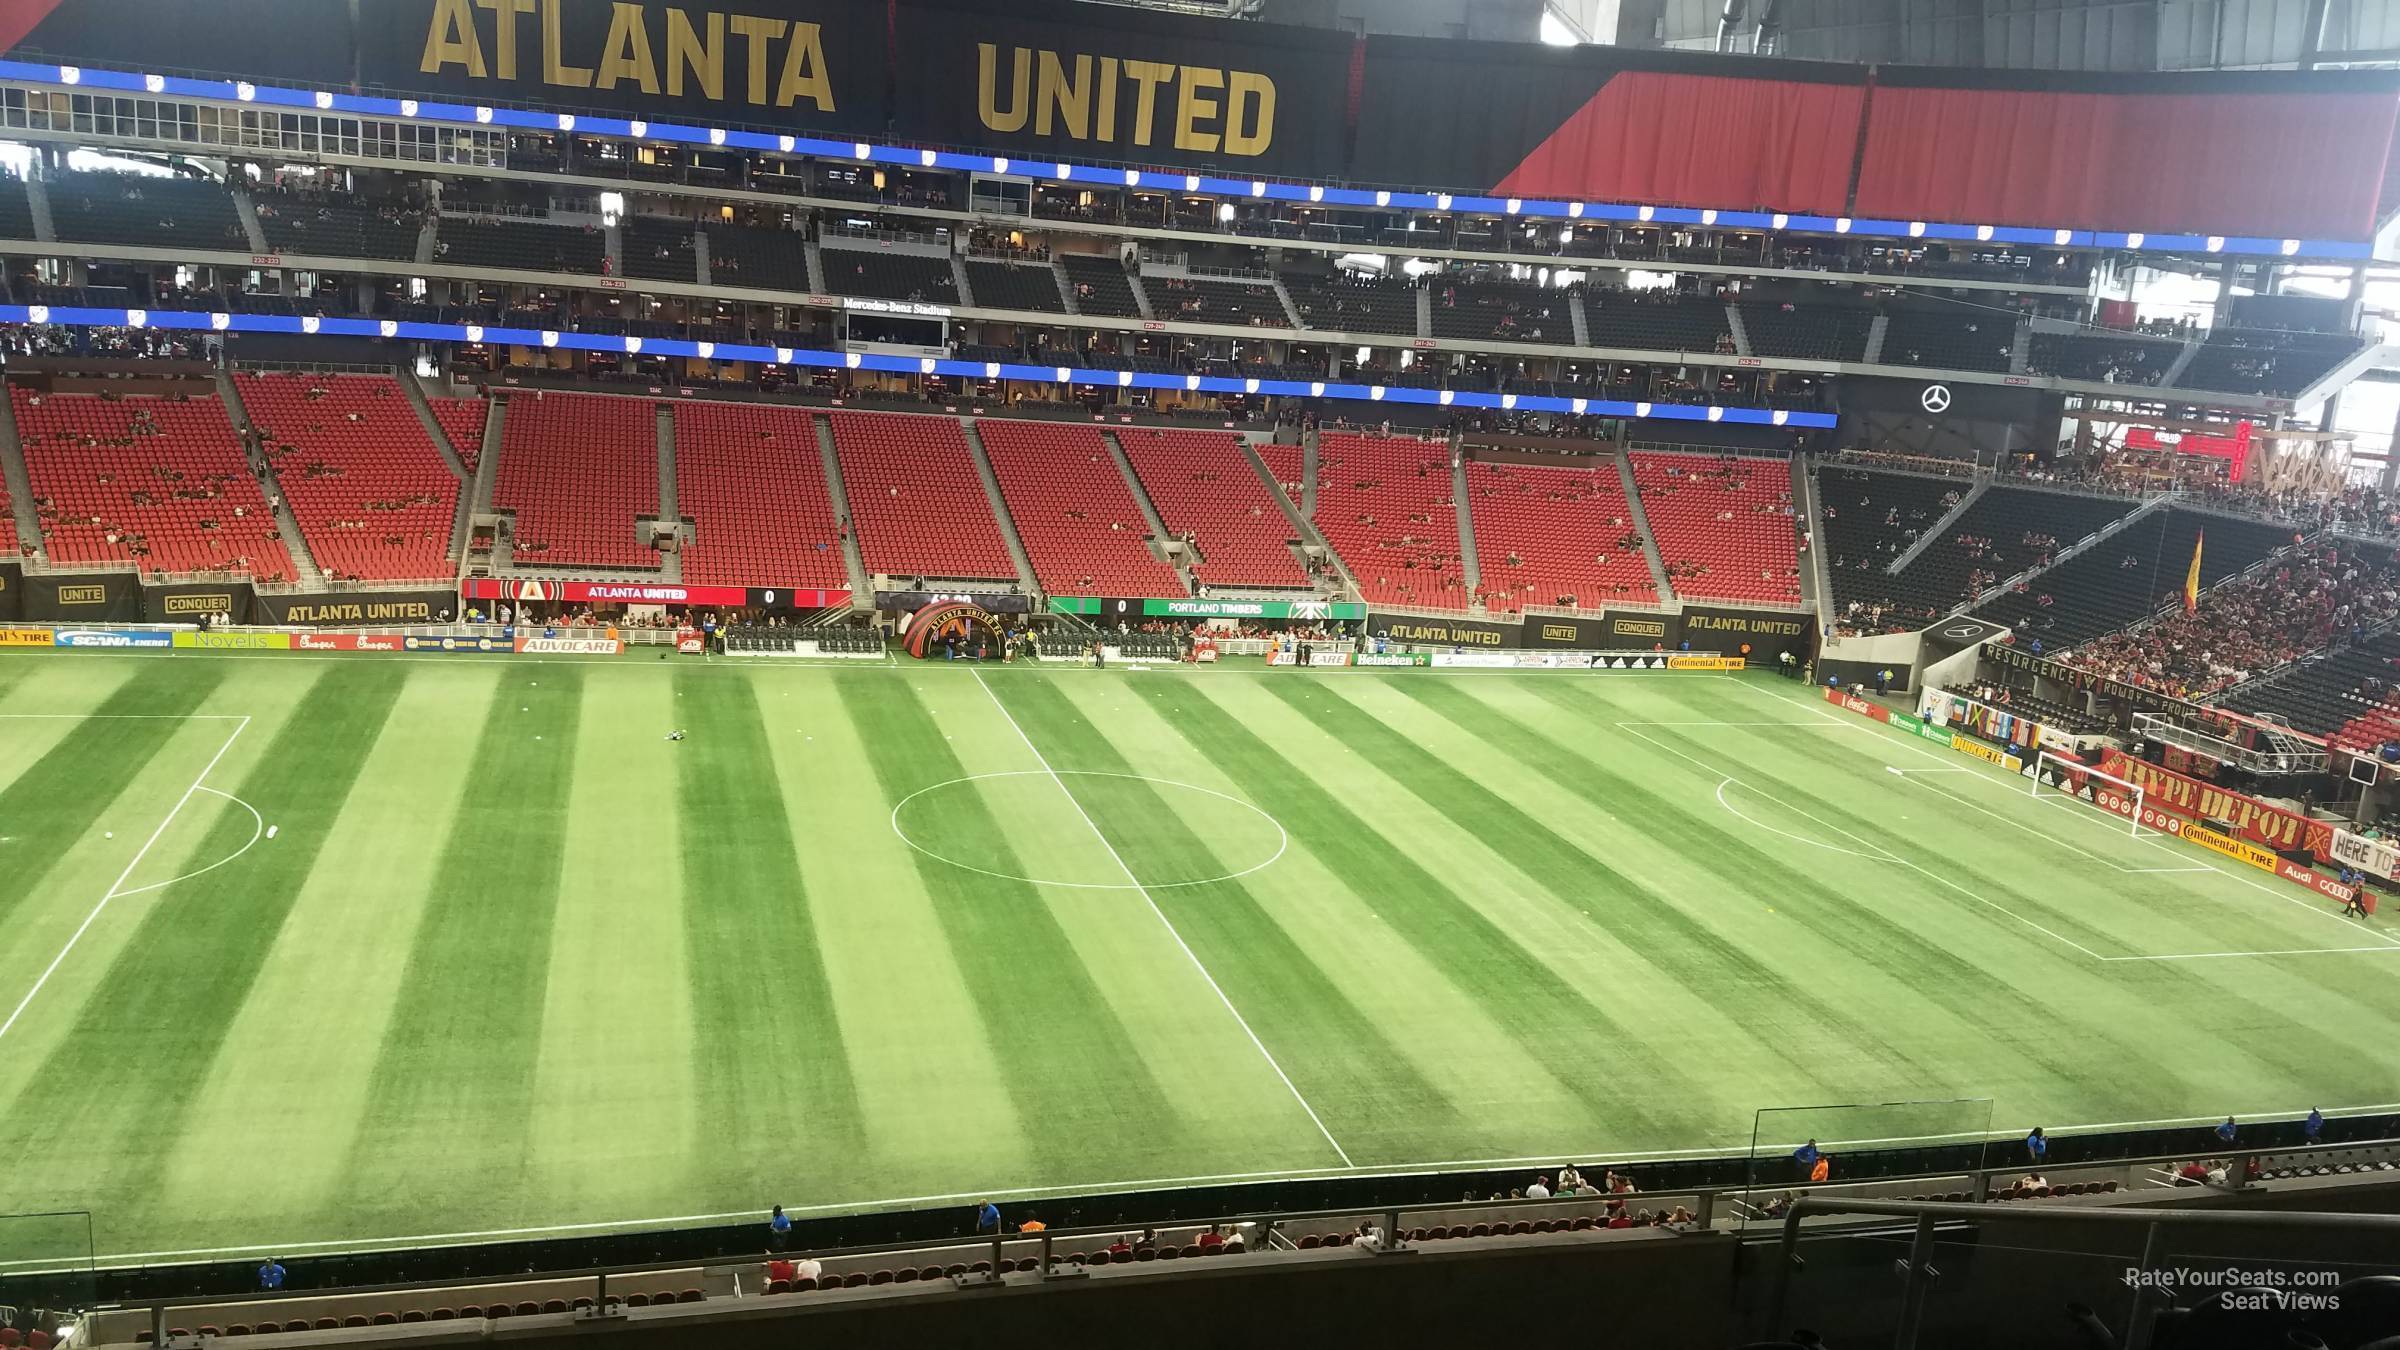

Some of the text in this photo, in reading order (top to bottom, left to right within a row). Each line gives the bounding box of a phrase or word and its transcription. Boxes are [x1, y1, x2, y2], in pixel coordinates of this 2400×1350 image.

[420, 0, 1276, 157] ATLANTA UNITED
[843, 297, 951, 316] Mercedes-Benz Stadium
[63, 589, 101, 601] UNITE
[588, 586, 687, 600] ATLANTA UNITED
[765, 590, 774, 603] 0
[169, 598, 227, 610] CONQUER
[1117, 600, 1126, 612] 0
[1169, 602, 1262, 614] PORTLAND TIMBERS
[287, 603, 429, 622] ATLANTA UNITED
[931, 610, 962, 631] ATLANTA
[966, 610, 995, 625] UNITED
[1546, 627, 1575, 639] UNITE
[1617, 622, 1661, 634] CONQUER
[1688, 616, 1801, 636] ATLANTA UNITED
[22, 633, 50, 642] TIRE
[195, 632, 268, 648] Novelis
[1390, 624, 1500, 645] ATLANTA UNITED
[525, 640, 616, 652] ADVOCARE
[1275, 652, 1345, 664] ADCARE
[1357, 653, 1413, 666] Heineken
[1670, 656, 1716, 668] Continental
[1986, 645, 2075, 684] RESURGENCE
[2104, 682, 2142, 702] ROWDY
[1952, 734, 2003, 764] QUIKRETE
[2123, 758, 2198, 810] HYPE
[2200, 788, 2299, 845] DEPOT
[2184, 824, 2273, 868] Continental TIRE
[2336, 837, 2392, 872] HERE TO
[2285, 865, 2312, 884] Audi
